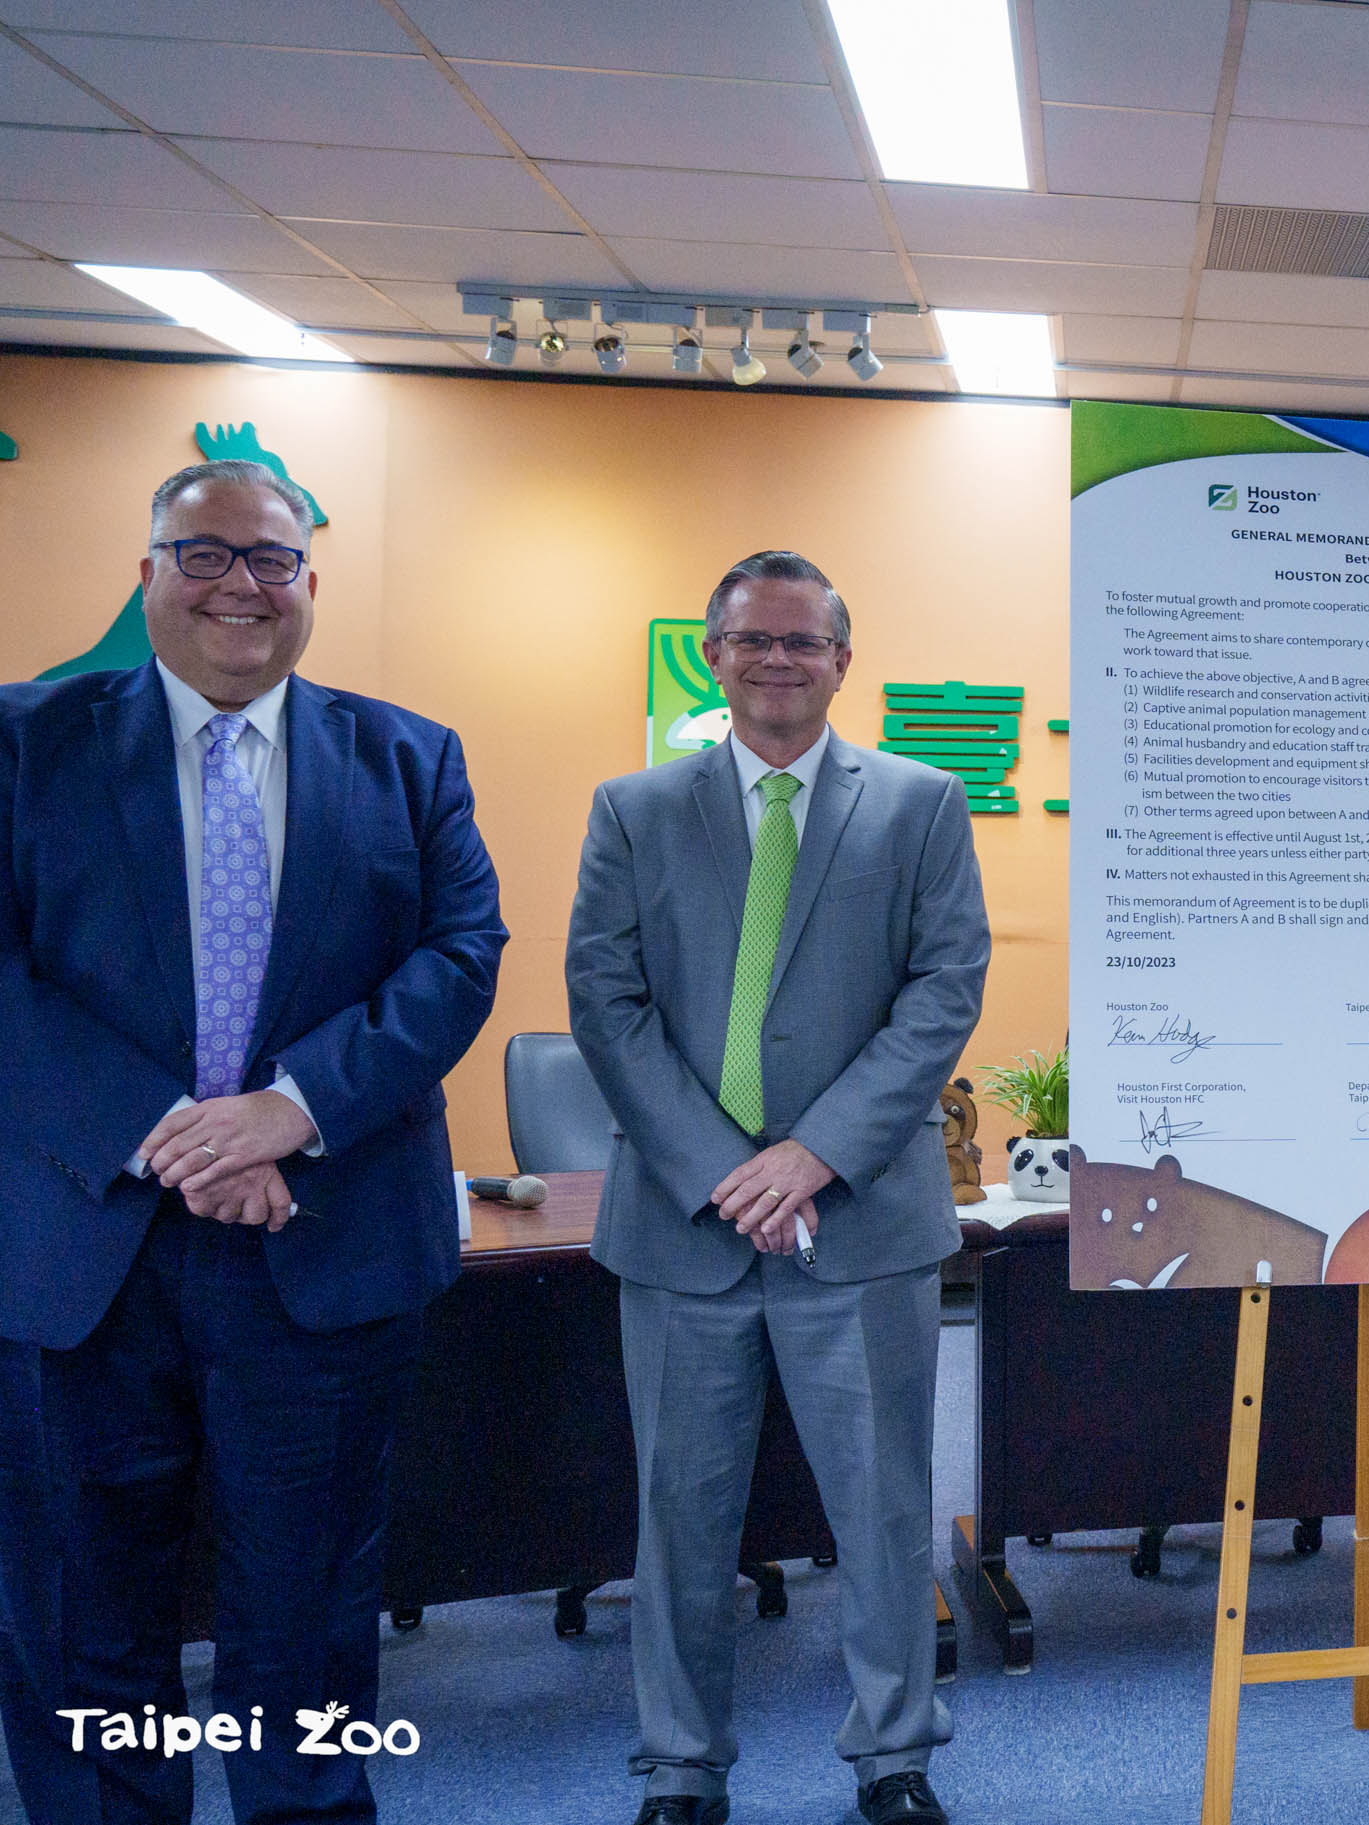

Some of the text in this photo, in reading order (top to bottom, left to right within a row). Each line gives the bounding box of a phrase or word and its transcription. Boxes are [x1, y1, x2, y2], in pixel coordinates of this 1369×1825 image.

[1248, 486, 1316, 502] Houston
[1248, 501, 1280, 514] Zoo
[1231, 527, 1293, 541] GENERAL
[1274, 568, 1342, 582] HOUSTON
[1106, 589, 1120, 601] To
[1121, 590, 1153, 603] foster
[1155, 592, 1196, 605] mutual
[1197, 593, 1238, 609] growth
[1239, 595, 1261, 607] and
[1263, 596, 1311, 612] promote
[1105, 603, 1244, 623] the following Agreement:
[1125, 627, 1145, 639] The
[1146, 628, 1209, 644] Agreement
[1211, 630, 1238, 643] aims
[1239, 631, 1252, 643] to
[1253, 632, 1284, 644] share
[1286, 633, 1363, 650] contemporary
[1123, 643, 1252, 660] work toward that issue.
[1105, 666, 1117, 678] II.
[1123, 667, 1138, 679] To
[1139, 667, 1183, 680] achieve
[1185, 669, 1205, 681] the
[1205, 669, 1241, 682] above
[1242, 671, 1296, 686] objective,
[1298, 672, 1306, 684] A
[1307, 673, 1329, 685] and
[1331, 673, 1340, 685] B
[1124, 701, 1139, 715] (2)
[1143, 701, 1186, 716] Captive
[1188, 703, 1227, 715] animal
[1229, 704, 1291, 719] population
[1292, 706, 1367, 721] management
[1124, 718, 1139, 732] (3)
[1143, 718, 1211, 732] Educational
[1212, 720, 1273, 735] promotion
[1274, 722, 1291, 734] for
[1292, 722, 1336, 737] ecology
[1337, 724, 1359, 736] and
[1124, 752, 1139, 766] (5)
[1143, 752, 1193, 765] Facilities
[1194, 754, 1271, 769] development
[1272, 755, 1295, 767] and
[1296, 756, 1358, 771] equipment
[1124, 804, 1139, 818] (7)
[1143, 804, 1177, 816] Other
[1179, 805, 1213, 817] terms
[1214, 806, 1254, 820] agreed
[1255, 810, 1286, 821] upon
[1287, 807, 1337, 820] between
[1338, 808, 1347, 820] A
[1348, 808, 1369, 820] and
[1106, 868, 1121, 879] IV.
[1124, 868, 1168, 880] Matters
[1170, 869, 1190, 880] not
[1191, 869, 1251, 881] exhausted
[1252, 870, 1264, 881] in
[1266, 870, 1288, 881] this
[1289, 870, 1351, 884] Agreement
[1106, 928, 1175, 942] Agreement.
[1106, 955, 1176, 969] 23/10/2023
[1106, 1001, 1169, 1011] Houston Zoo
[1117, 1081, 1246, 1093] Houston First Corporation,
[1117, 1093, 1205, 1103] Visit Houston HFC
